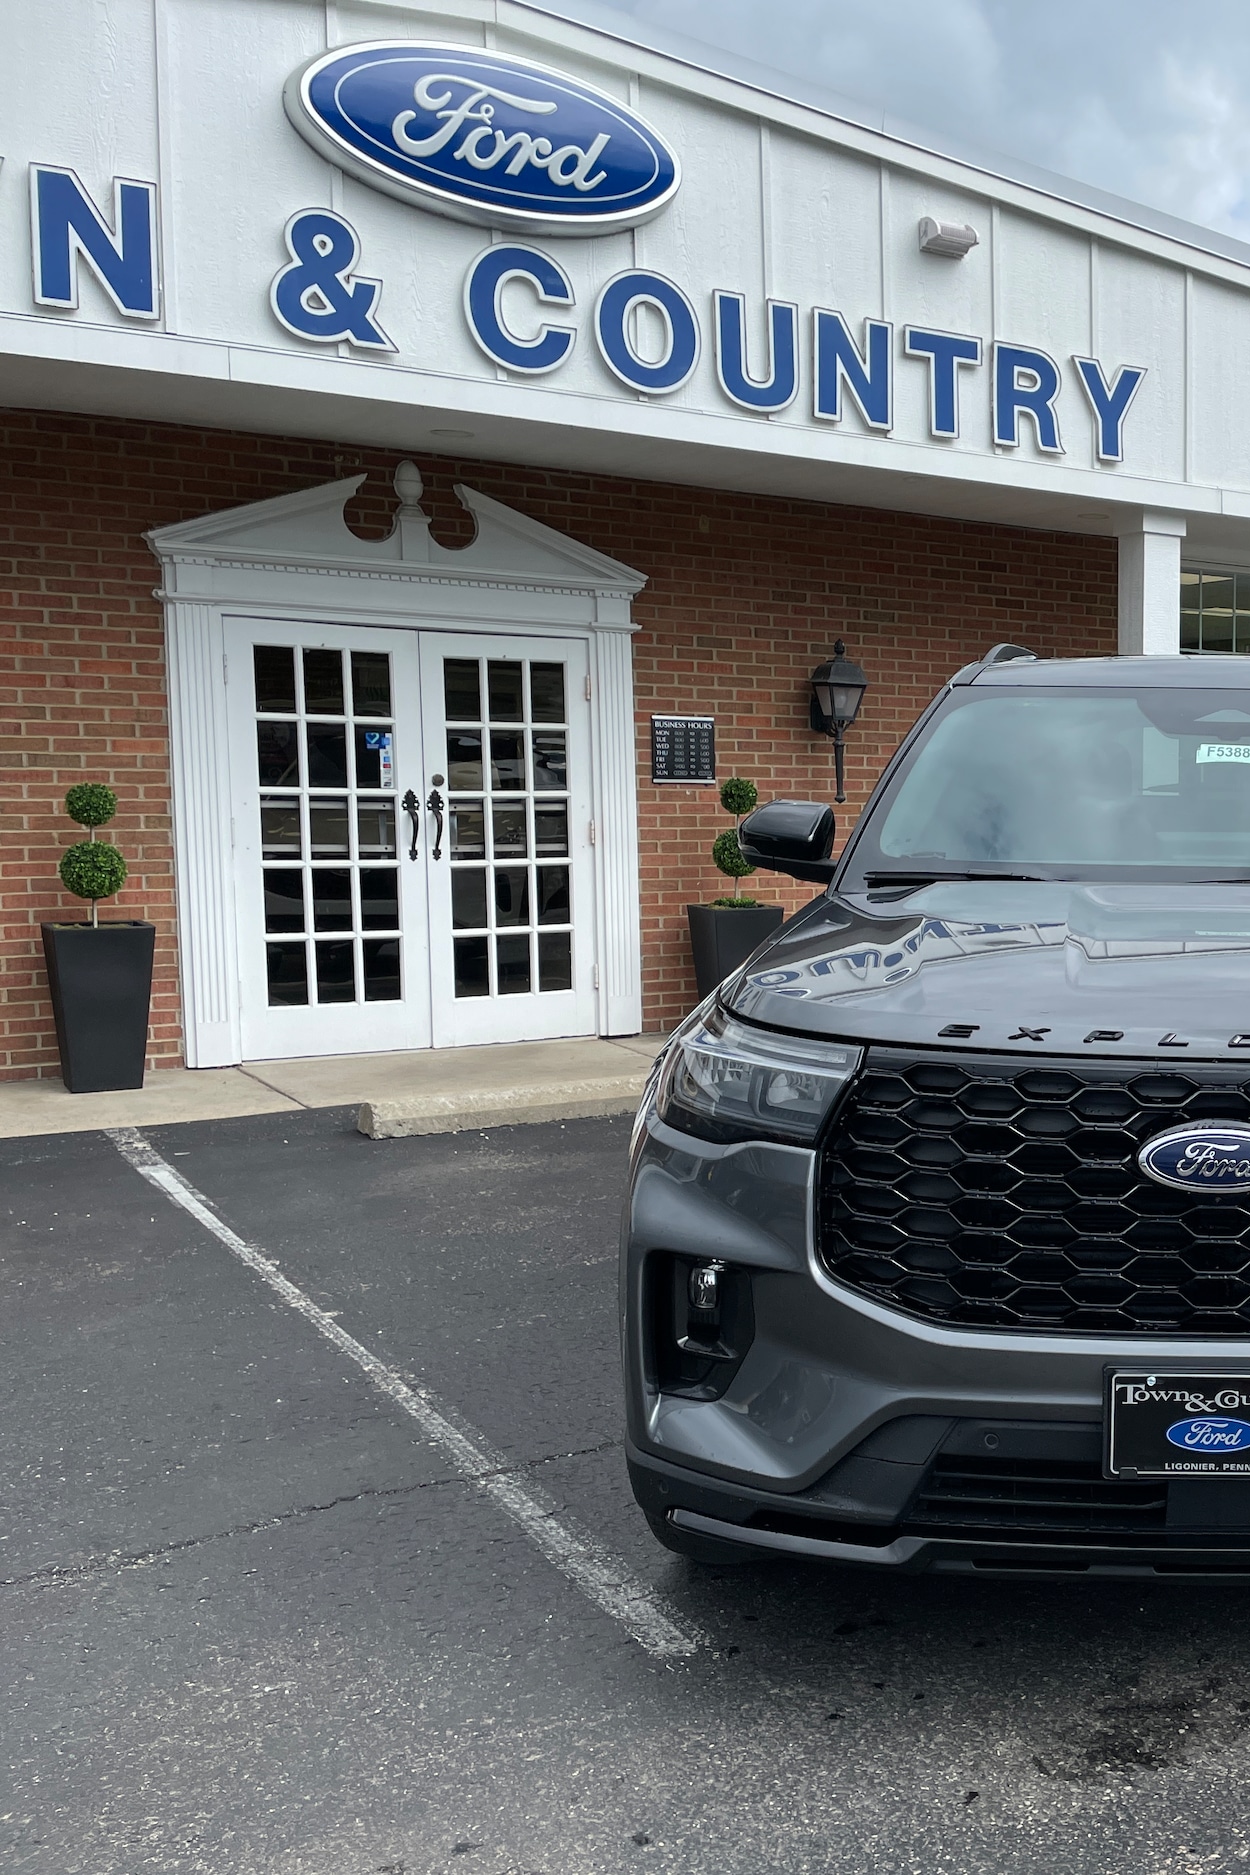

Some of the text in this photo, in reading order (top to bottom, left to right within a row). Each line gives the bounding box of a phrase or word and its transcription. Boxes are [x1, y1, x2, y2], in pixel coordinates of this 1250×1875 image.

[391, 73, 612, 192] Ford
[28, 161, 1148, 462] N & COUNTRY
[1207, 746, 1250, 758] F5388
[1184, 1421, 1243, 1446] Ford
[1164, 1462, 1219, 1471] LIGONIER,
